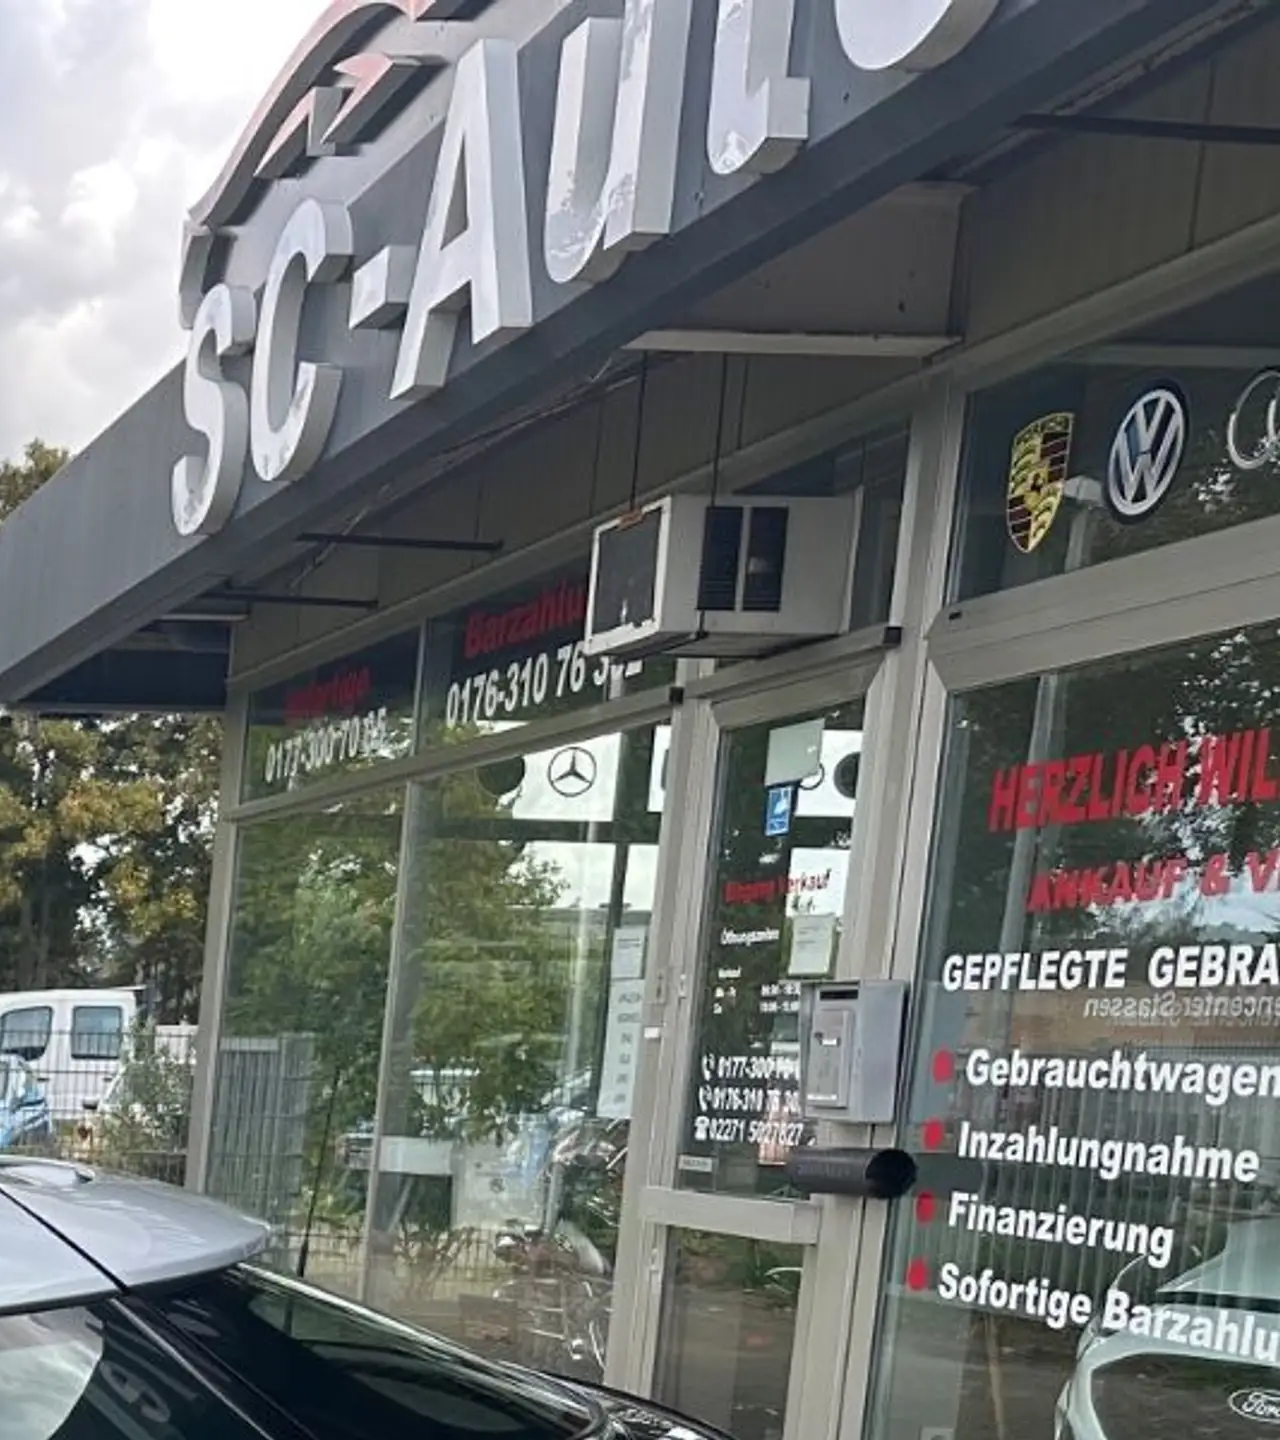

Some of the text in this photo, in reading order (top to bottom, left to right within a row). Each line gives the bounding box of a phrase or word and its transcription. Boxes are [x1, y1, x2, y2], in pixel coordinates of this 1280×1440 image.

[445, 651, 549, 730] 0176-310
[555, 639, 588, 698] 76
[989, 736, 1189, 834] HERZLICH
[1027, 845, 1280, 913] ANKAUF & V
[942, 942, 1280, 993] GEPFLEGTE GEBRA
[965, 1048, 1280, 1106] Gebrauchtwagen
[957, 1120, 1260, 1182] Inzahlungnahme
[947, 1191, 1175, 1268] Finanzierung
[938, 1262, 1280, 1362] Sofortige Barzahlu
